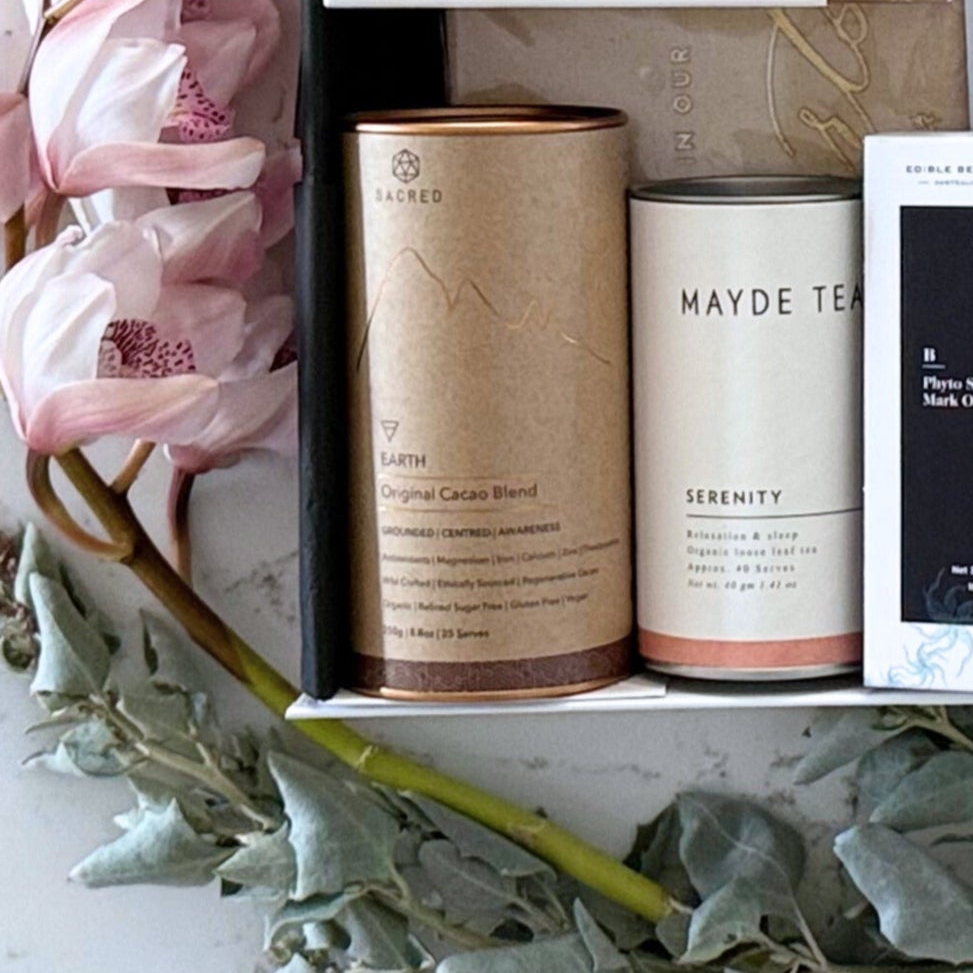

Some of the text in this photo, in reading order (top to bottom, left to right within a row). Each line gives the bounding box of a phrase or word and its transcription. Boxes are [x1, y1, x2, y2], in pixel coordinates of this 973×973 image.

[669, 47, 693, 115] OUR
[906, 165, 951, 174] EDIBLE
[375, 188, 442, 204] SACRED
[681, 283, 864, 317] MAYDE TEA
[923, 347, 936, 362] B
[922, 376, 962, 393] Phyto
[922, 394, 958, 408] Mark
[381, 453, 426, 468] EARTH
[381, 484, 537, 503] Original Cacao Blend
[686, 489, 782, 505] SERENITY
[687, 529, 747, 541] Relaxation
[767, 531, 799, 542] sleep
[687, 546, 728, 557] Organic
[735, 546, 766, 557] loose
[756, 562, 796, 573] Serves
